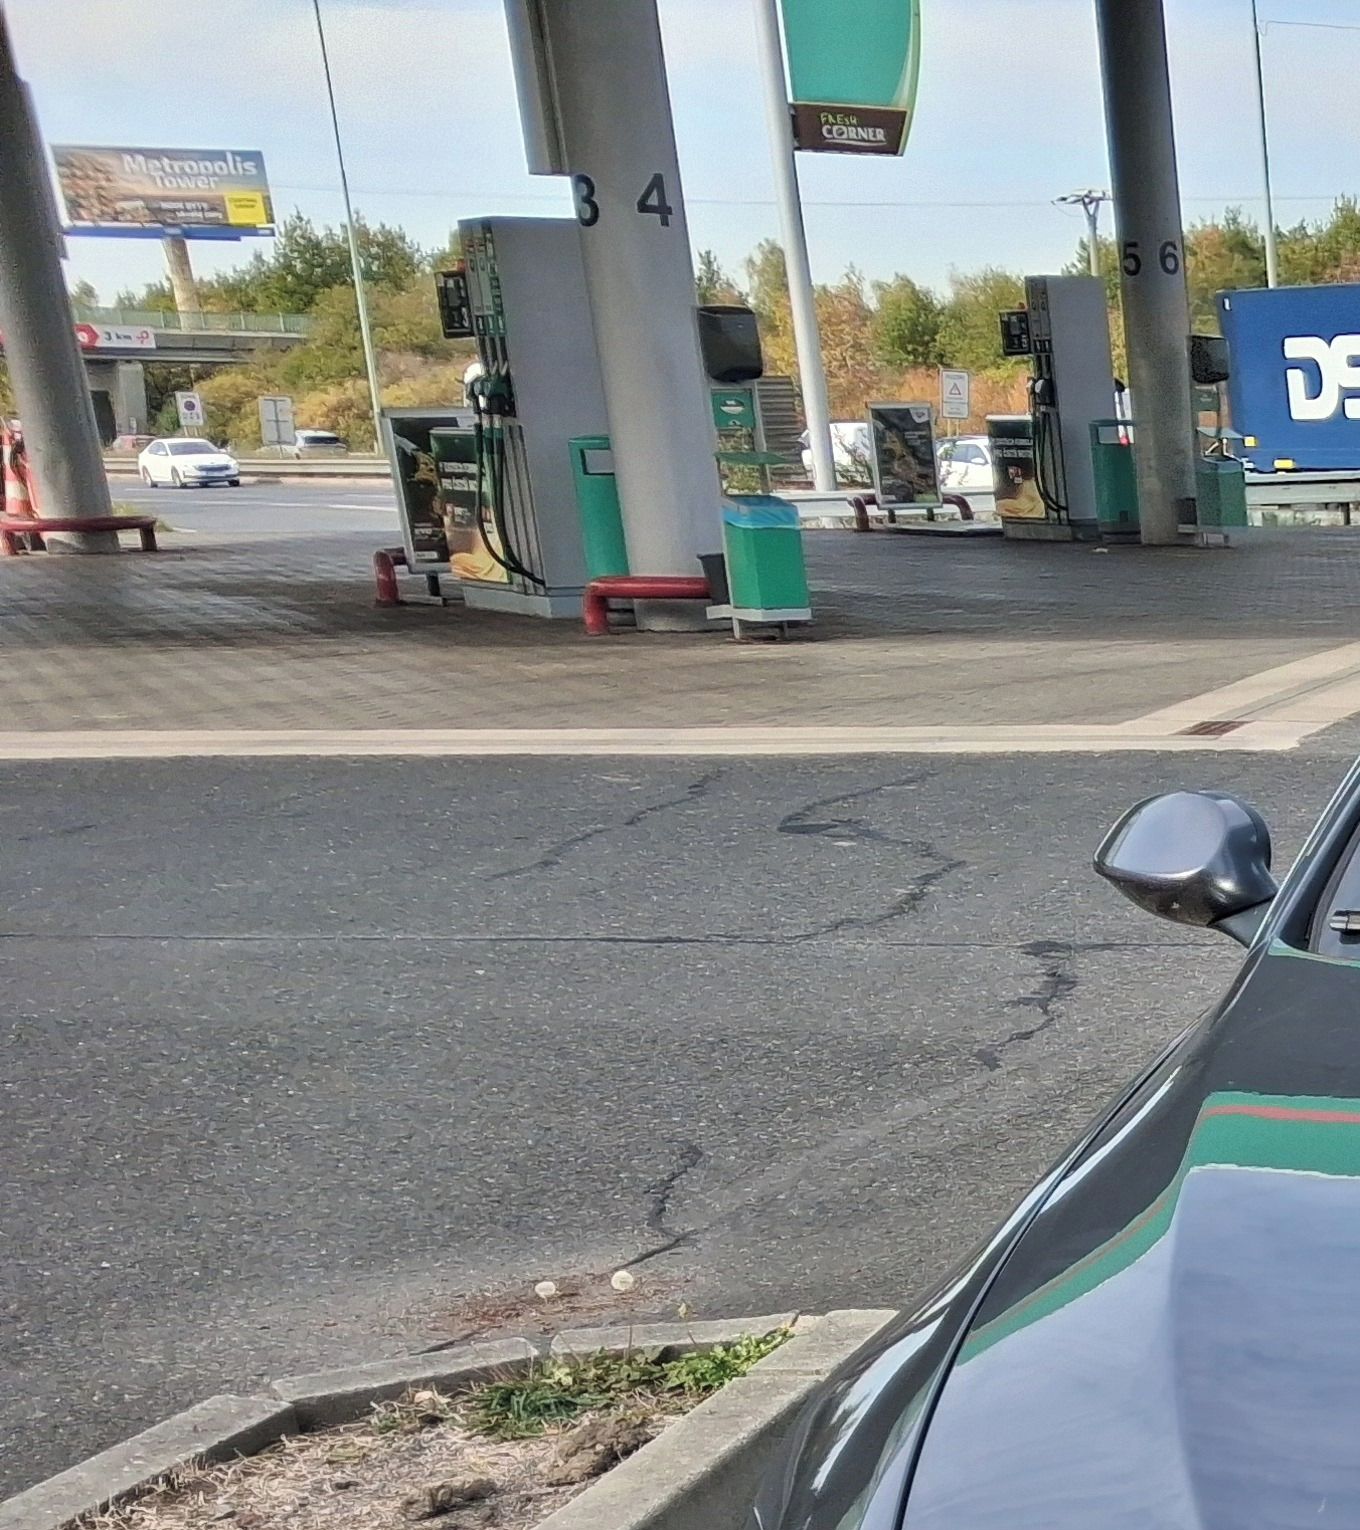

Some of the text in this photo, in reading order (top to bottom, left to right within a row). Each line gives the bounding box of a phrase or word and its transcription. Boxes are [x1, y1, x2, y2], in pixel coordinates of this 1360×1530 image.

[821, 124, 886, 142] CORNER
[121, 151, 258, 176] Metropolis
[152, 171, 220, 189] Tower
[575, 172, 673, 227] 3 4
[1123, 241, 1179, 276] 5 6
[104, 331, 112, 342] 3
